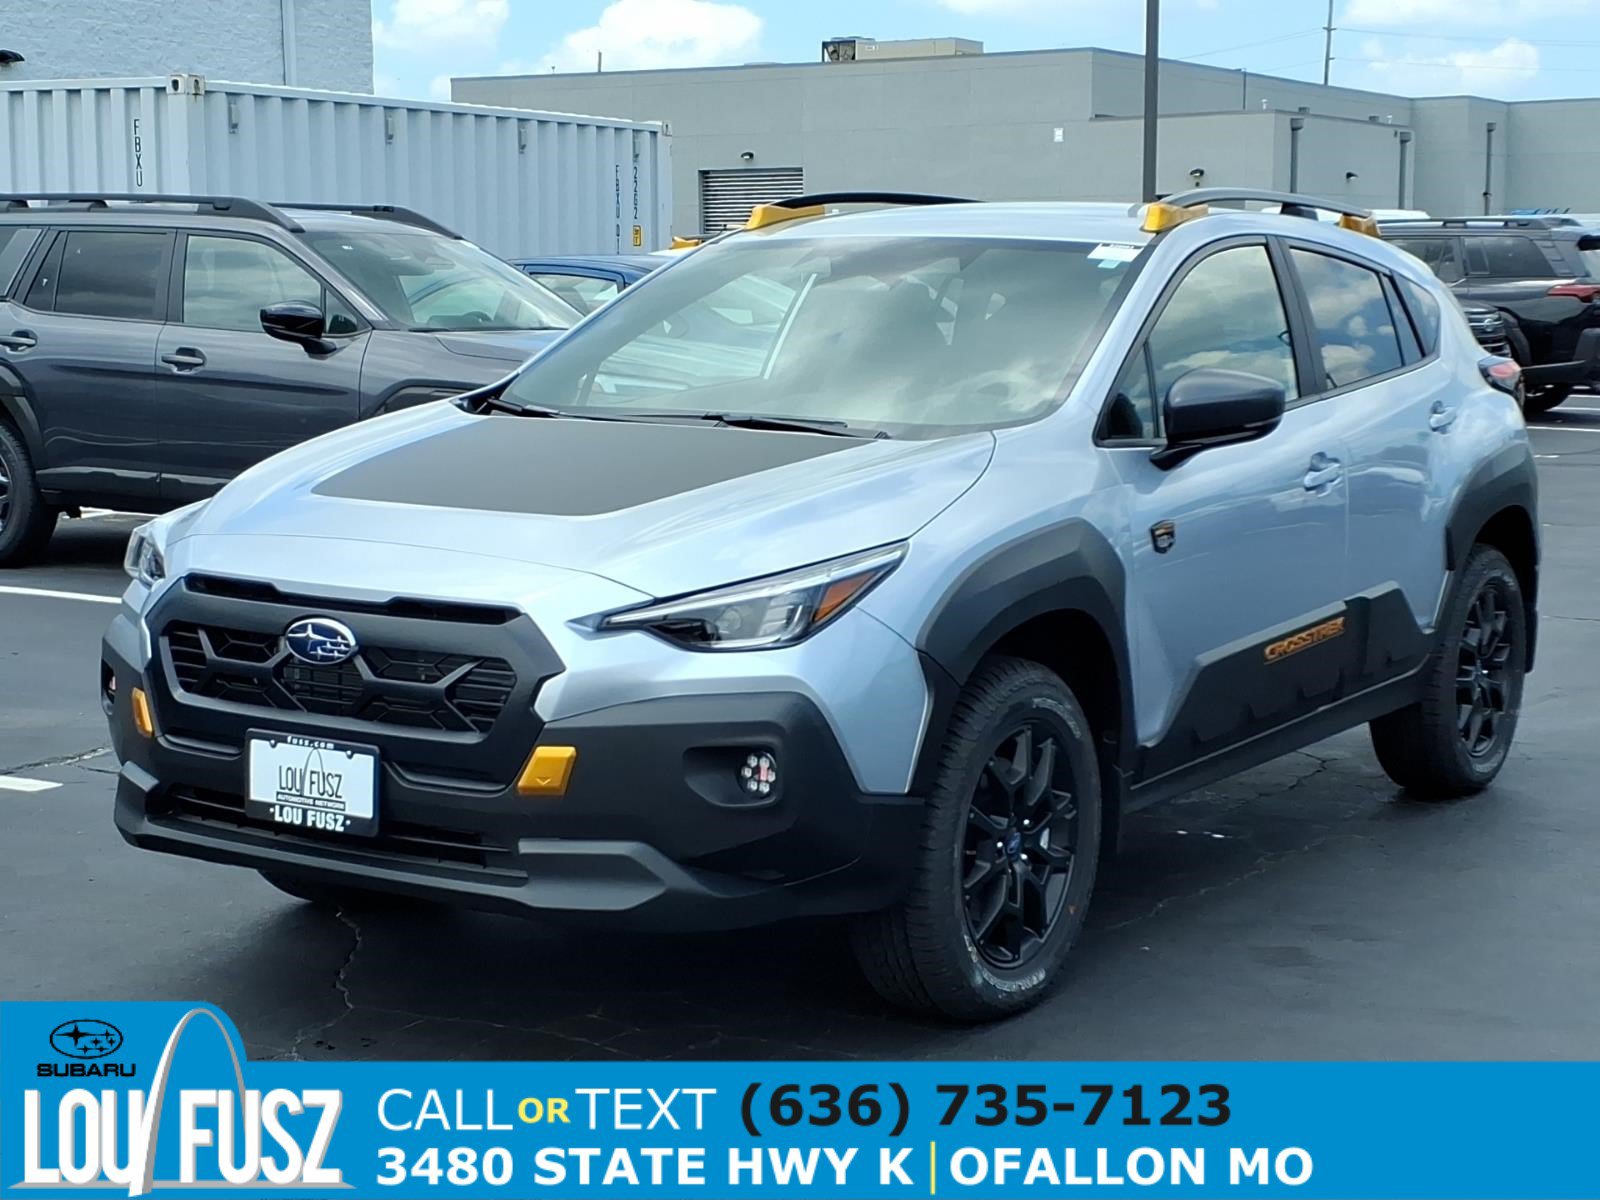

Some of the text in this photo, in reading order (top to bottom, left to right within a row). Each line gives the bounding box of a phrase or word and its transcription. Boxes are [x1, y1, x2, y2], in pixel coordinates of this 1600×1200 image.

[133, 118, 143, 187] FBXU
[1264, 616, 1345, 660] CROSSTREK
[278, 765, 343, 799] LOU FUSZ
[274, 804, 346, 832] LOU FUSZ
